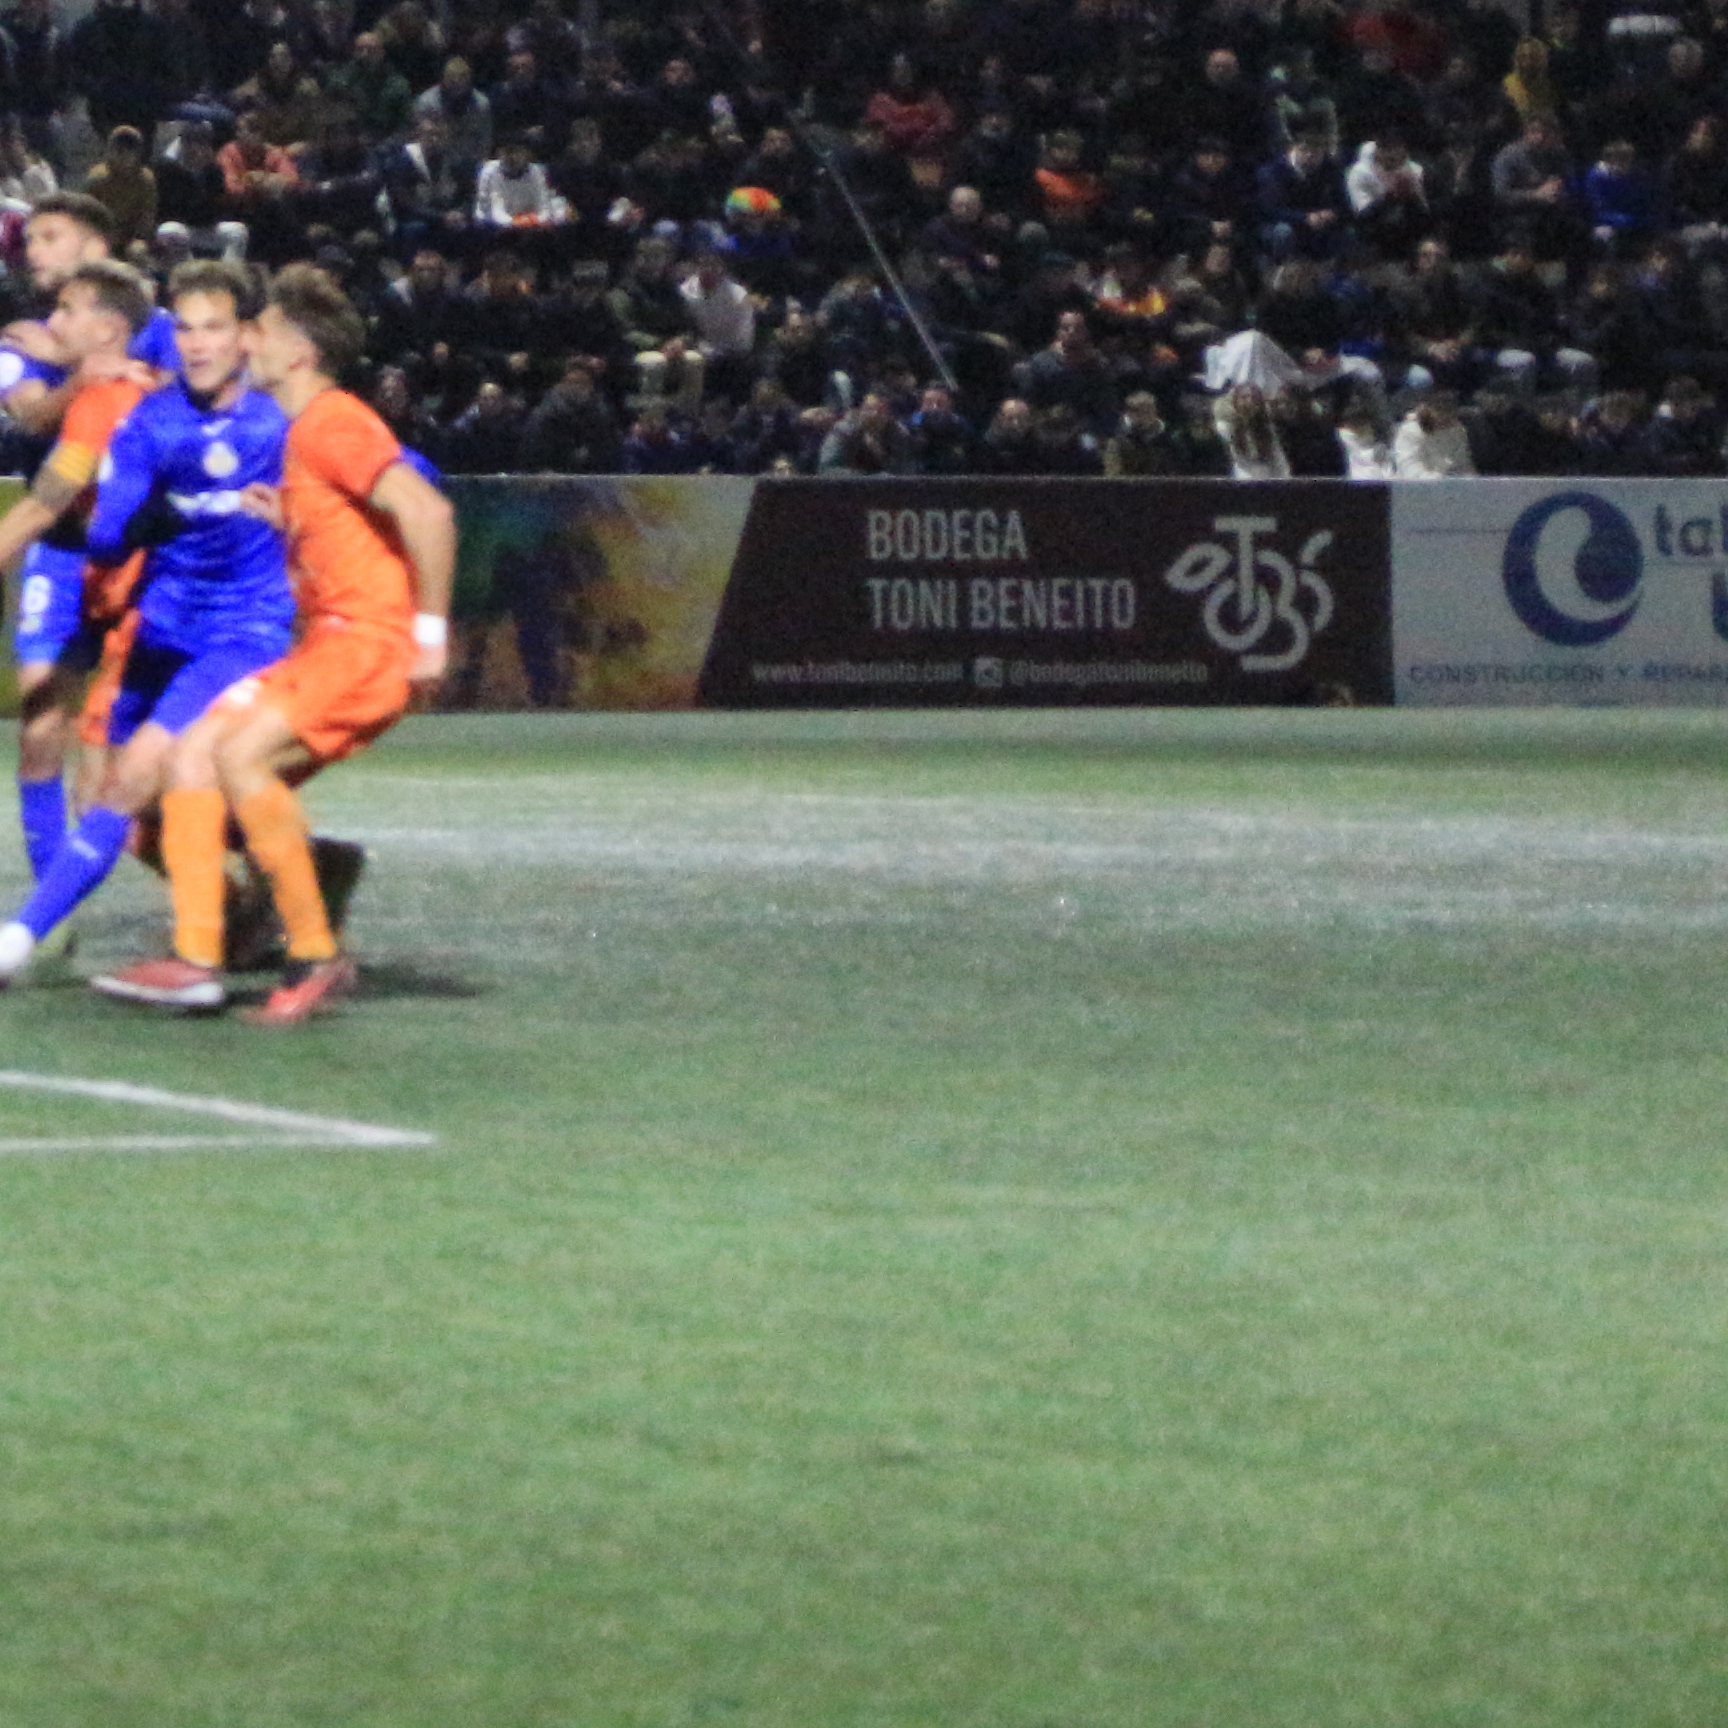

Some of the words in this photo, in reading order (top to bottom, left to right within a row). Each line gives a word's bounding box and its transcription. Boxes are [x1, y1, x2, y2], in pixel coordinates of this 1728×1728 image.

[866, 509, 1029, 561] BODEGA
[866, 578, 959, 630] TONI
[970, 578, 1137, 630] BENEITO
